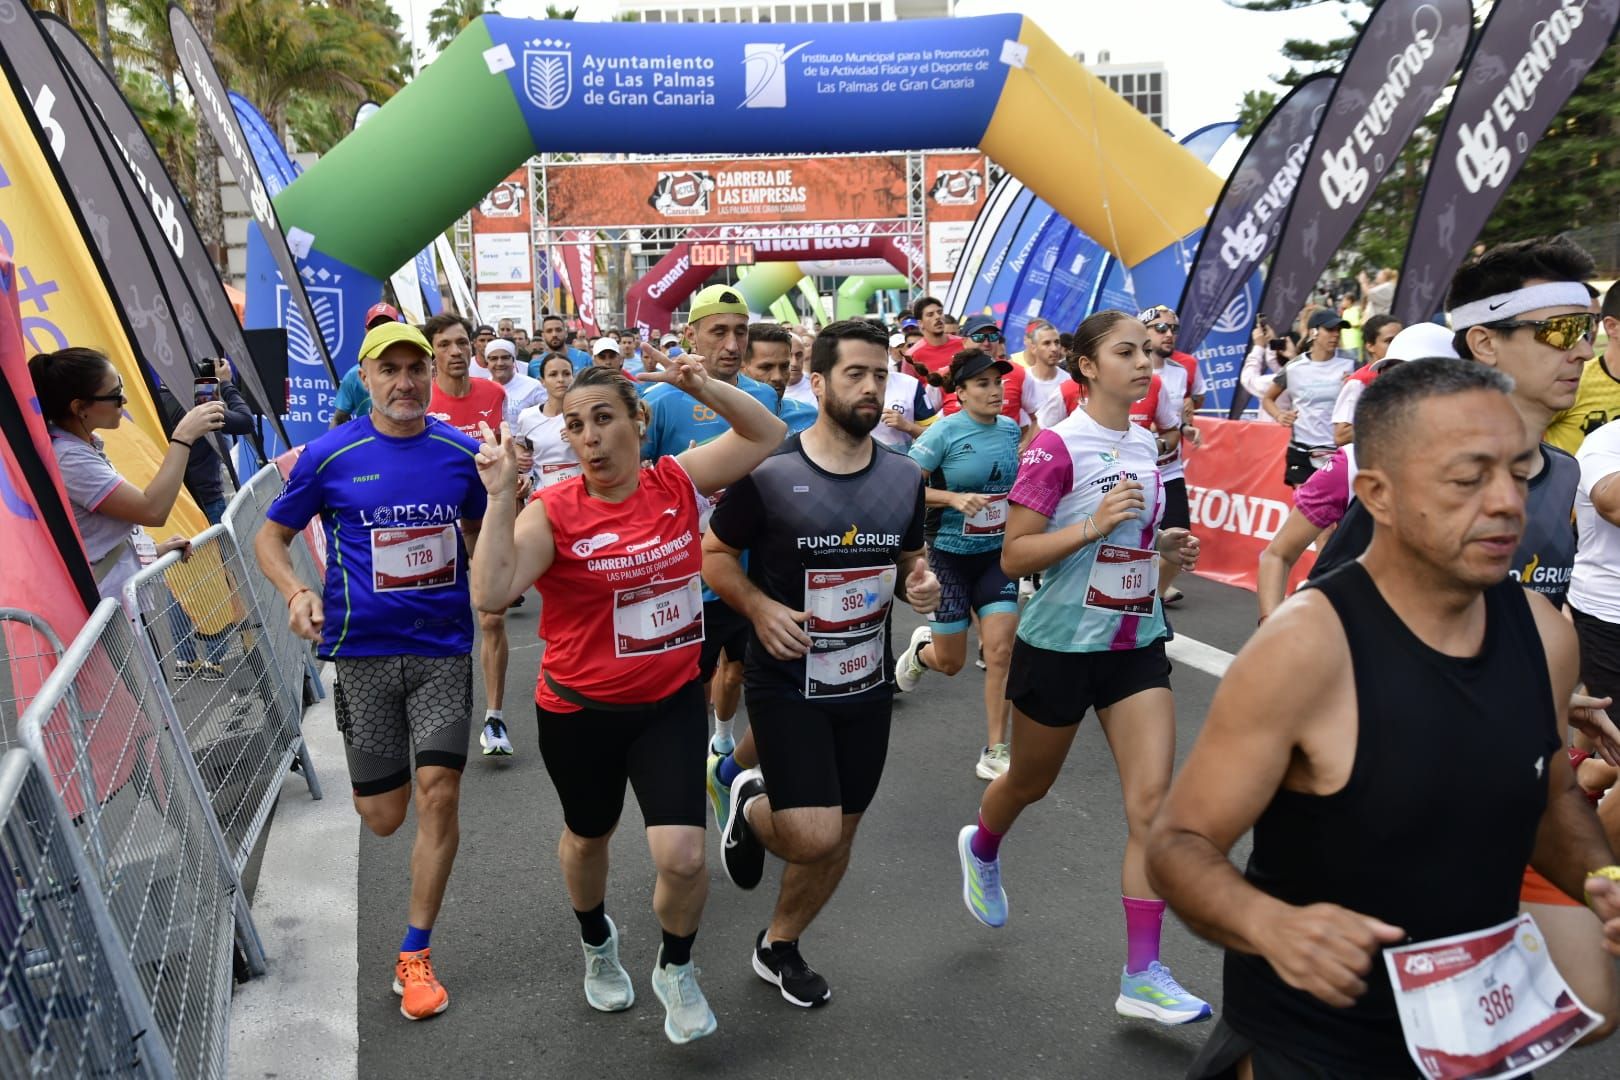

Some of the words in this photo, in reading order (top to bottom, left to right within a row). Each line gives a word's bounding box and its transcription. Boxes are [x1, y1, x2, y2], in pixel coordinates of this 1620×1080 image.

[582, 54, 715, 72] Ayuntamiento
[801, 53, 843, 64] Instituto
[845, 51, 895, 64] Municipal
[897, 52, 921, 63] para
[922, 50, 932, 60] la
[934, 47, 989, 59] Promoción
[803, 66, 817, 76] de
[819, 66, 830, 76] la
[831, 64, 878, 76] Actividad
[910, 66, 917, 77] y
[919, 62, 929, 73] el
[931, 62, 973, 75] Deporte
[975, 61, 990, 71] de
[1492, 0, 1583, 132] EVENTOS
[583, 71, 605, 87] de
[615, 72, 643, 87] Las
[653, 72, 715, 87] Palmas
[816, 81, 836, 93] Las
[838, 80, 879, 93] Palmas
[881, 80, 896, 92] de
[899, 78, 929, 91] Gran
[931, 76, 976, 90] Canaria
[583, 89, 605, 105] de
[608, 90, 648, 105] Gran
[653, 90, 715, 105] Canaria
[1353, 29, 1434, 154] EVENTOS
[717, 171, 775, 187] CARRERA
[776, 170, 792, 185] DE
[717, 189, 741, 205] LAS
[742, 187, 807, 203] EMPRESAS
[1206, 361, 1235, 375] Las
[287, 394, 307, 405] as
[352, 473, 380, 483] FASTER
[360, 503, 458, 527] LOPESAN
[1185, 484, 1290, 541] HOND
[797, 534, 841, 549] FUND
[854, 533, 900, 547] GRUBE
[405, 549, 433, 568] 1728
[587, 555, 635, 572] CARRERA
[635, 553, 647, 564] DE
[647, 548, 661, 561] LAS
[661, 530, 693, 556] EMPRESAS
[813, 547, 848, 556] SHOPPING
[606, 571, 620, 582] LAS
[620, 567, 646, 580] PALMAS
[653, 560, 668, 571] GRAN
[668, 551, 690, 566] CANARIA
[1122, 574, 1142, 590] 1613
[841, 593, 864, 612] 392
[651, 604, 680, 628] 1744
[840, 655, 868, 676] 3690
[1478, 984, 1516, 1027] 386
